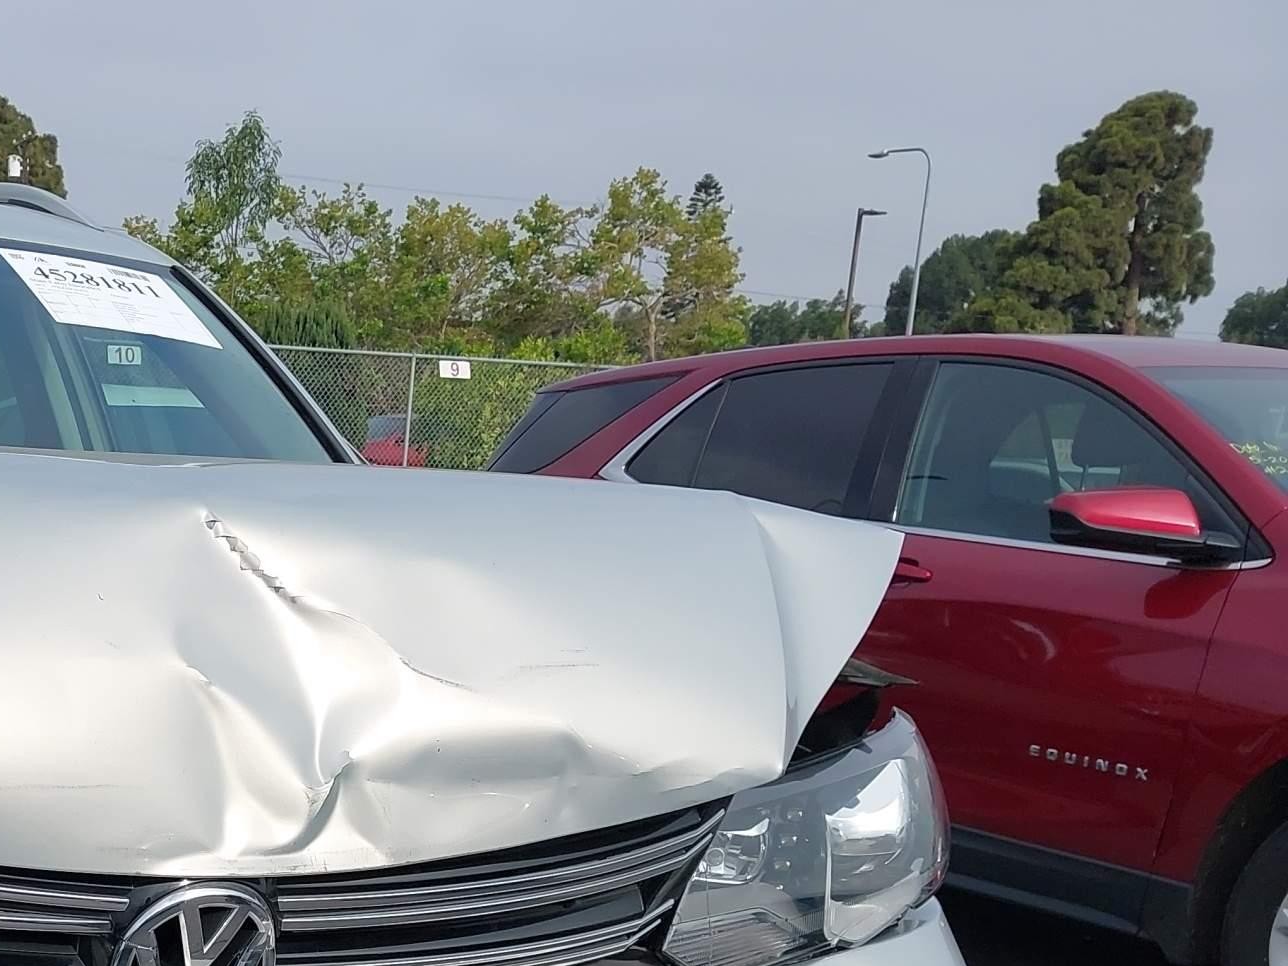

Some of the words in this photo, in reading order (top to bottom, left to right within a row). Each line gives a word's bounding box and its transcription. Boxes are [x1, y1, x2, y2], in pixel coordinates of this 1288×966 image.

[33, 266, 161, 299] 45281811
[115, 346, 135, 364] 10
[450, 362, 460, 377] 9
[1029, 744, 1149, 781] EQUINOX
